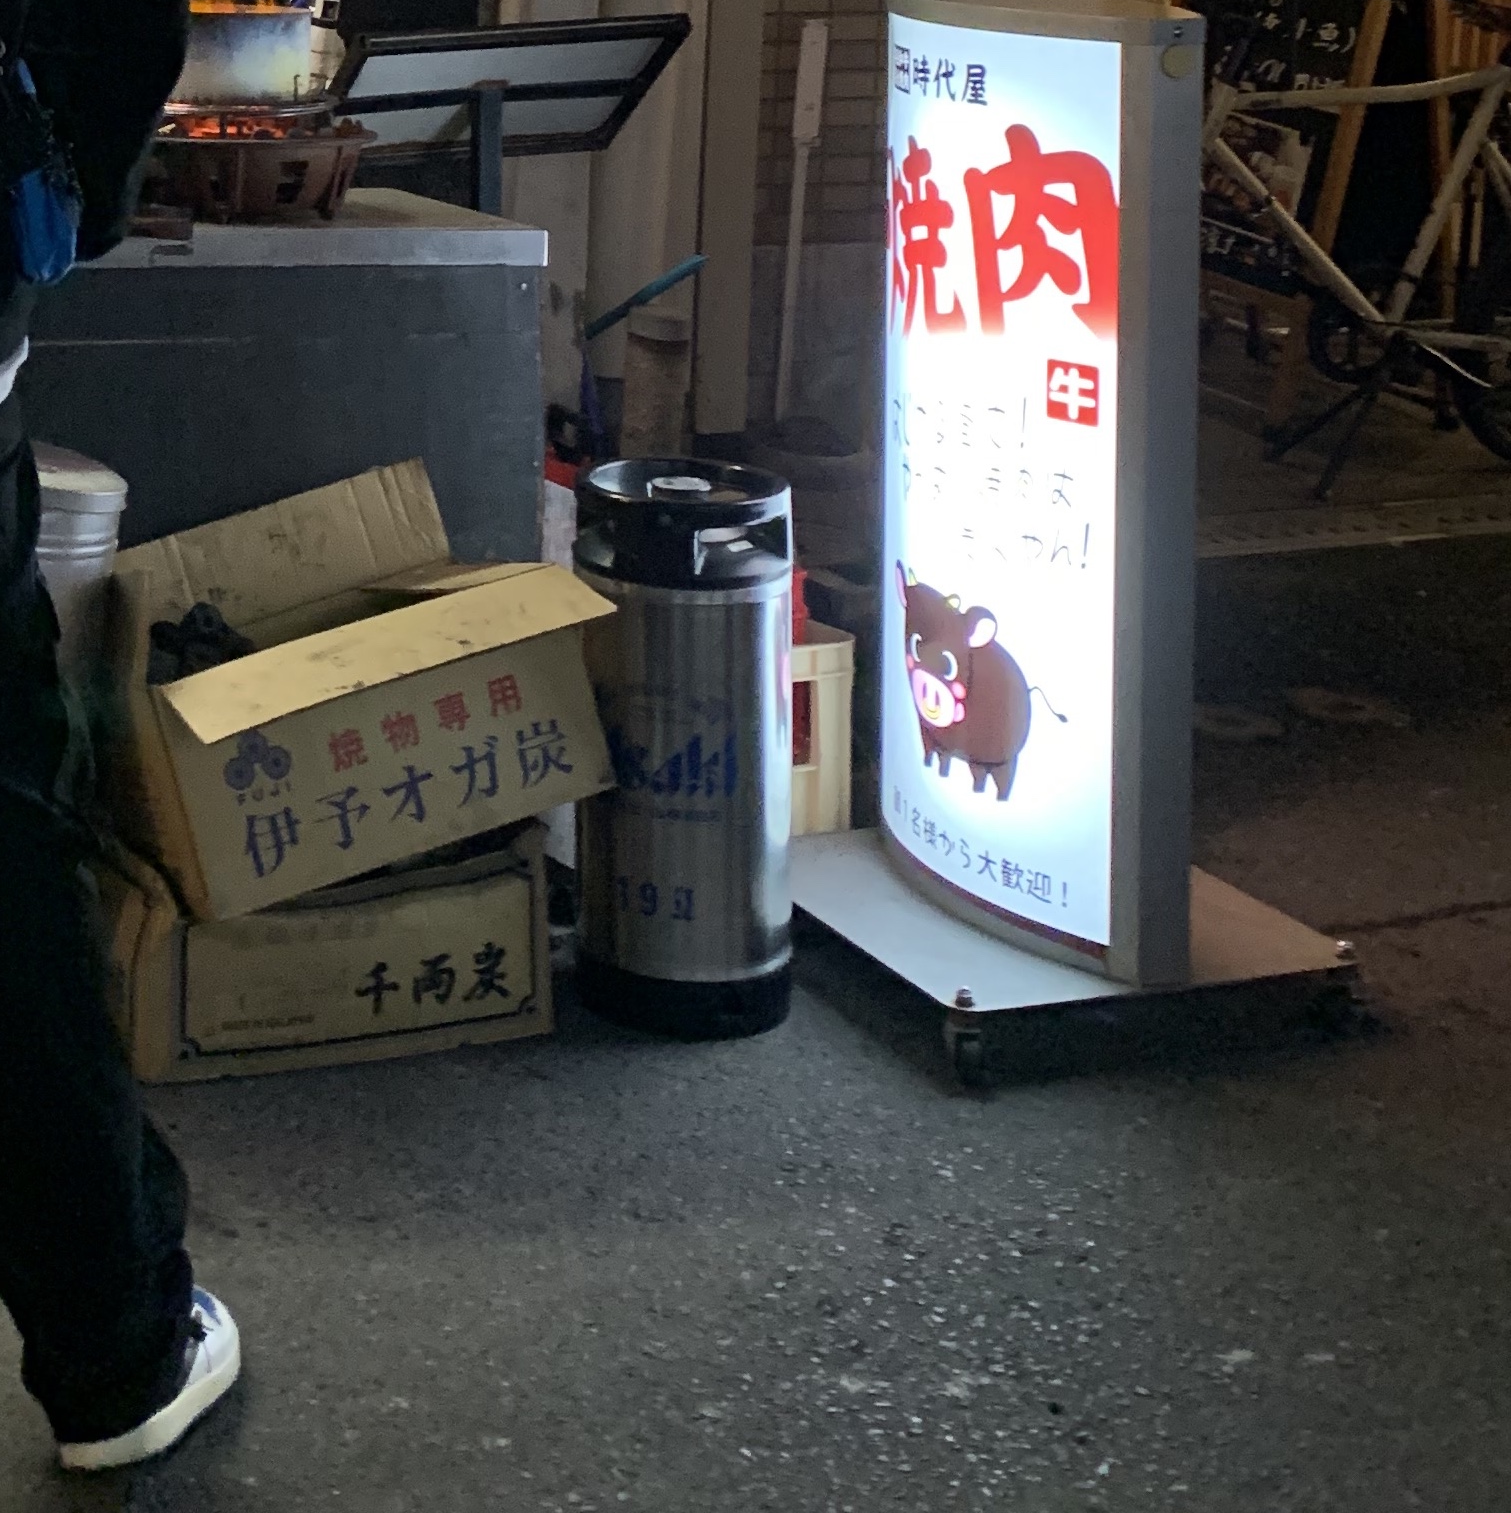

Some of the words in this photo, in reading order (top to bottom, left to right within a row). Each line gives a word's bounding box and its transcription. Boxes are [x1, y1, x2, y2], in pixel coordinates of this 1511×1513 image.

[1048, 362, 1098, 424] 牛
[243, 717, 573, 878] 伊予オガ炭
